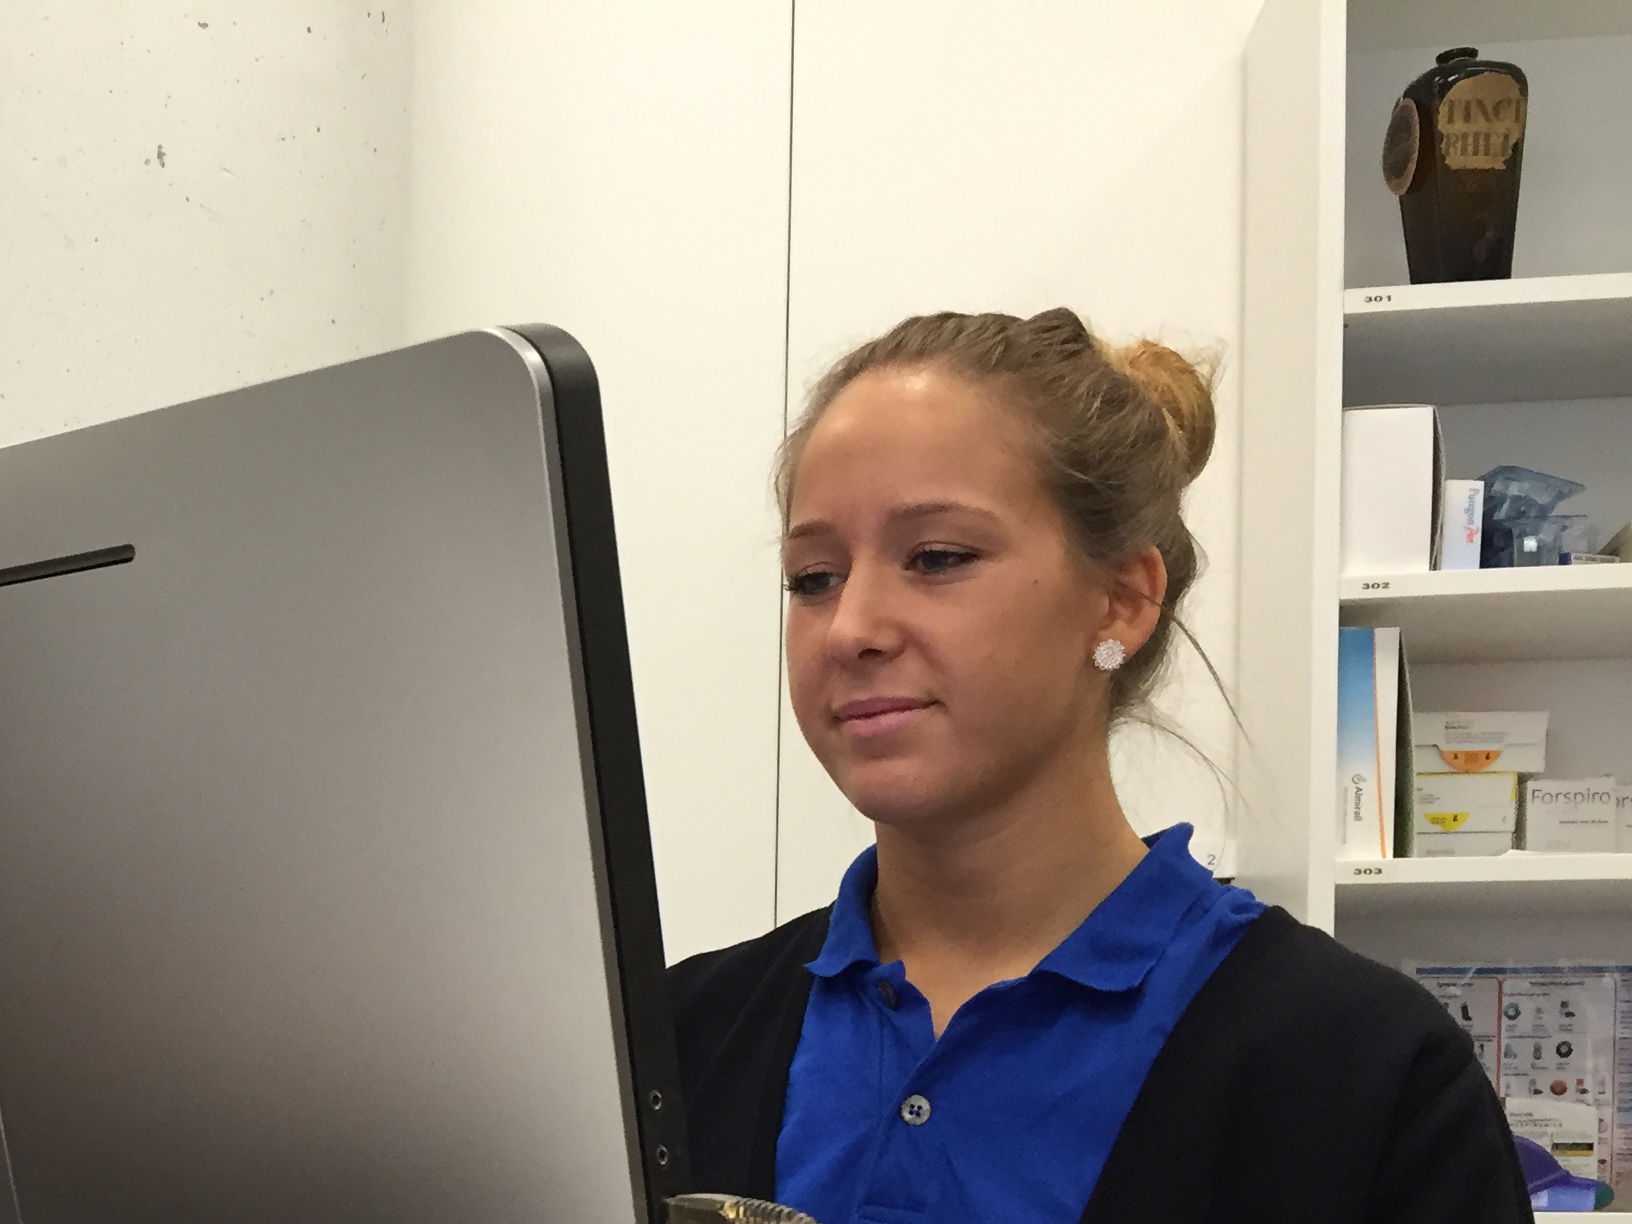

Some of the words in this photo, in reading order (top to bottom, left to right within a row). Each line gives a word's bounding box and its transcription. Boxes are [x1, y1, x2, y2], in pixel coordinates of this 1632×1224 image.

[1364, 295, 1392, 303] 301
[1362, 582, 1390, 590] 302
[1531, 788, 1611, 808] Forspiro
[1353, 868, 1383, 876] 303
